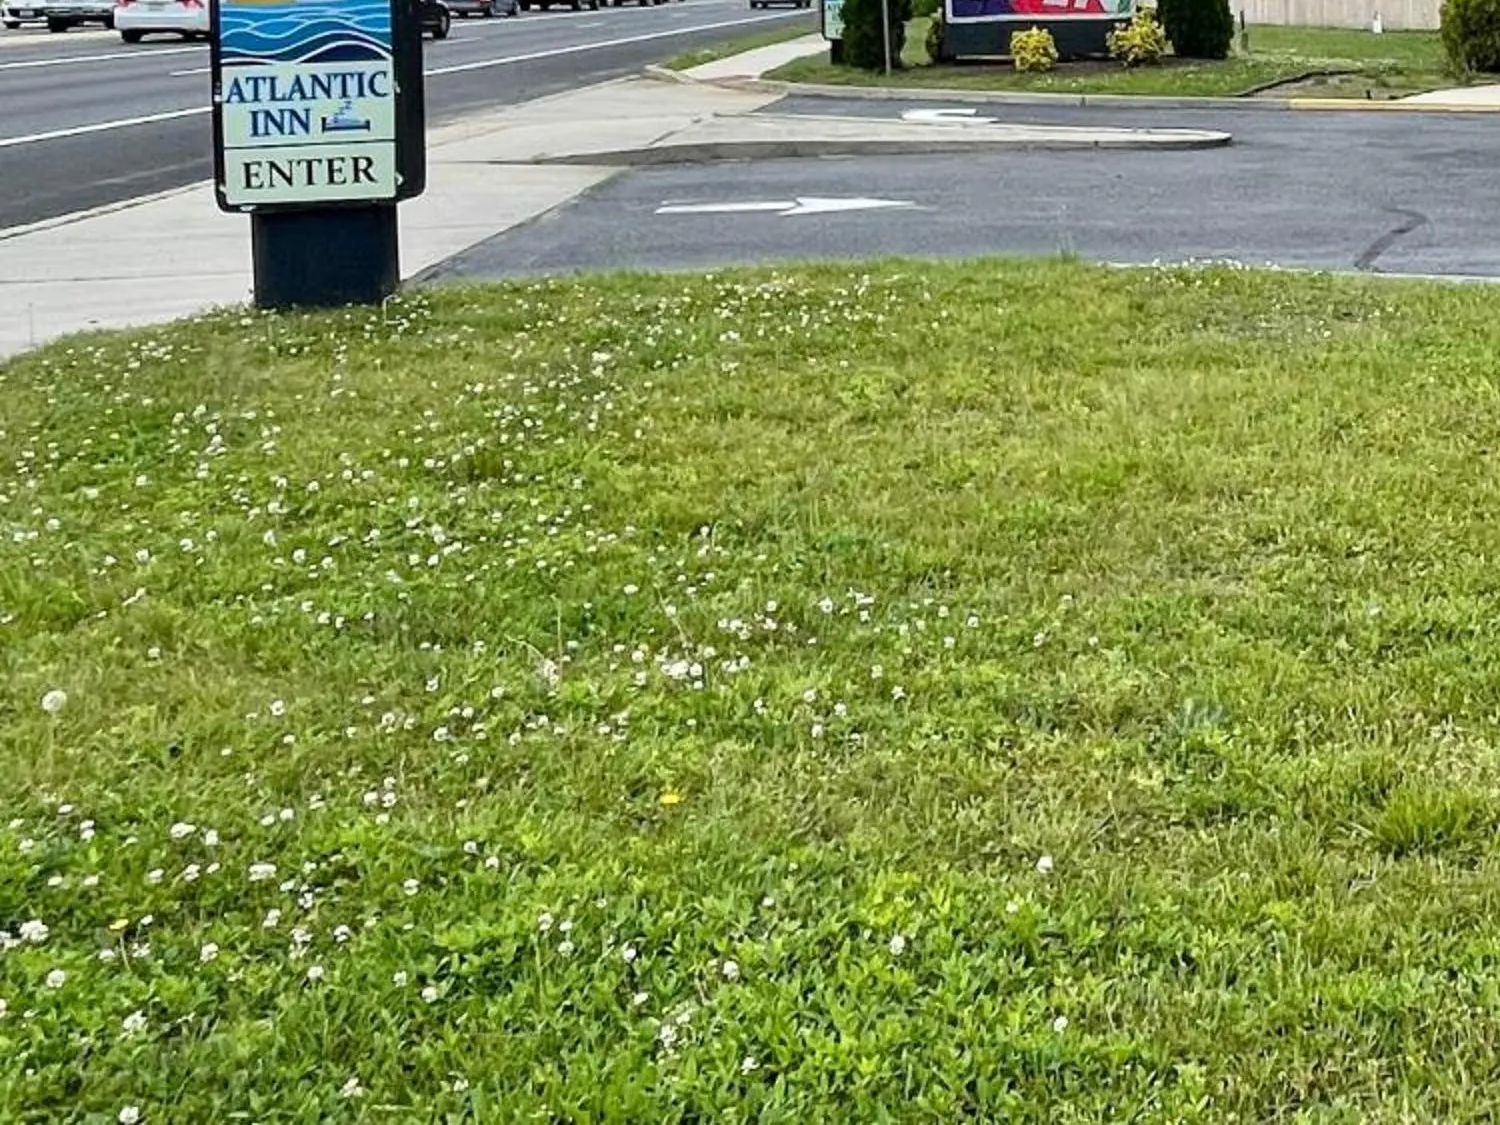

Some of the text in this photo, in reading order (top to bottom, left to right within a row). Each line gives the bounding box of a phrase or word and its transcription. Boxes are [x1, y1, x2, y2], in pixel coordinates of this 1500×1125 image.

[226, 70, 388, 104] ATLANTIC
[250, 108, 312, 137] INN
[243, 155, 378, 190] ENTER
